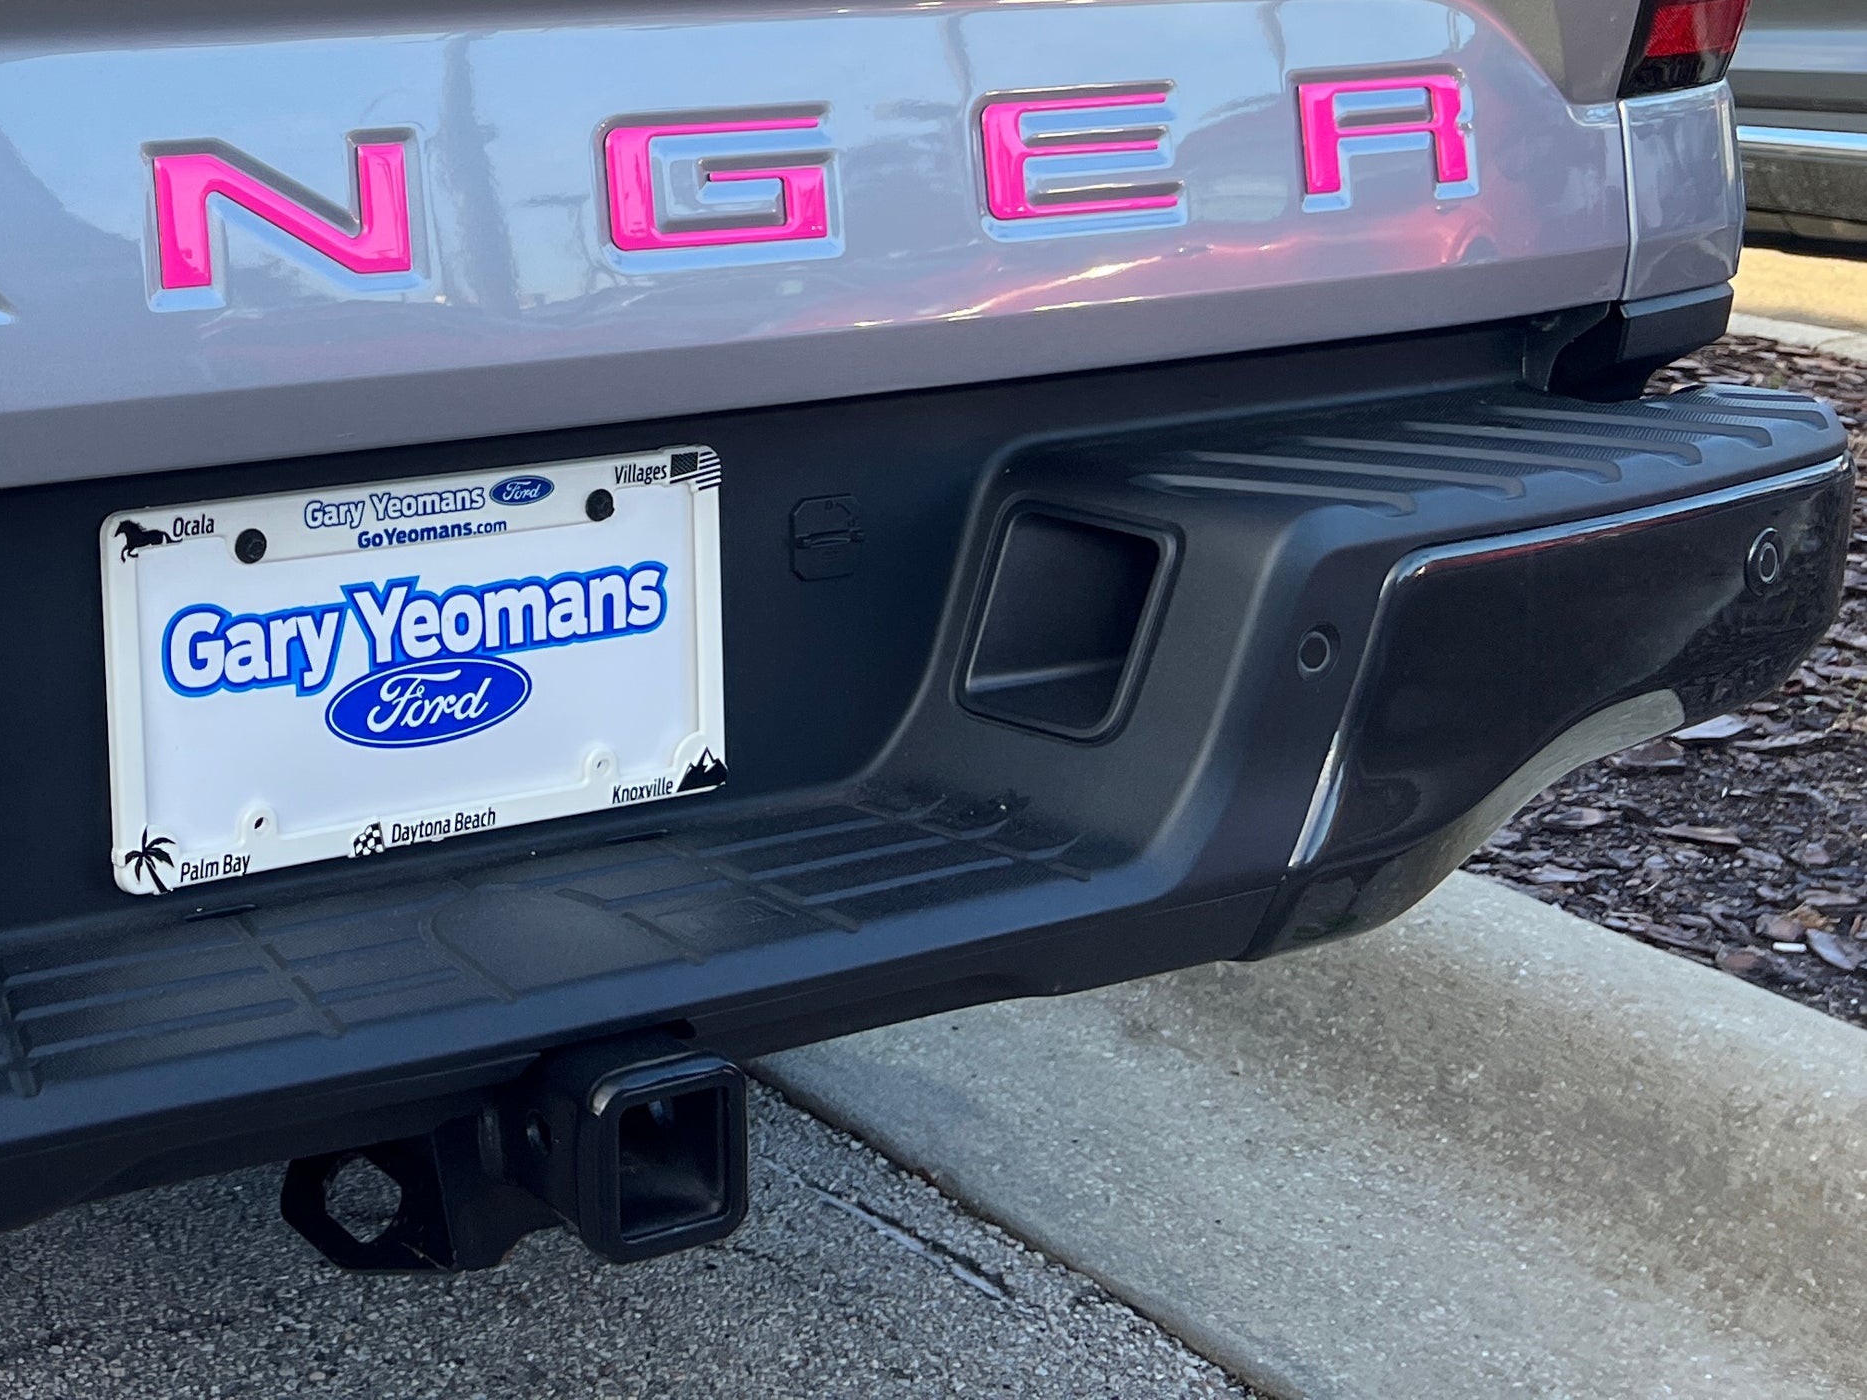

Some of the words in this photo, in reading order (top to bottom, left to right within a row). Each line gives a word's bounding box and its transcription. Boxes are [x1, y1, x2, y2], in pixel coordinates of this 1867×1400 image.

[614, 464, 667, 485] Villages
[305, 501, 364, 528] Gary
[370, 487, 485, 519] Yeomans
[501, 480, 542, 501] Ford
[173, 514, 215, 538] Ocala
[357, 519, 508, 549] GoYeomans.com
[168, 610, 341, 690] Gary
[351, 566, 663, 664] Yeomans
[366, 669, 493, 732] Ford
[612, 779, 674, 804] Knoxville
[391, 819, 450, 845] Daytona
[454, 808, 496, 832] Beach
[180, 861, 218, 883] Palm
[222, 853, 250, 879] Bay
